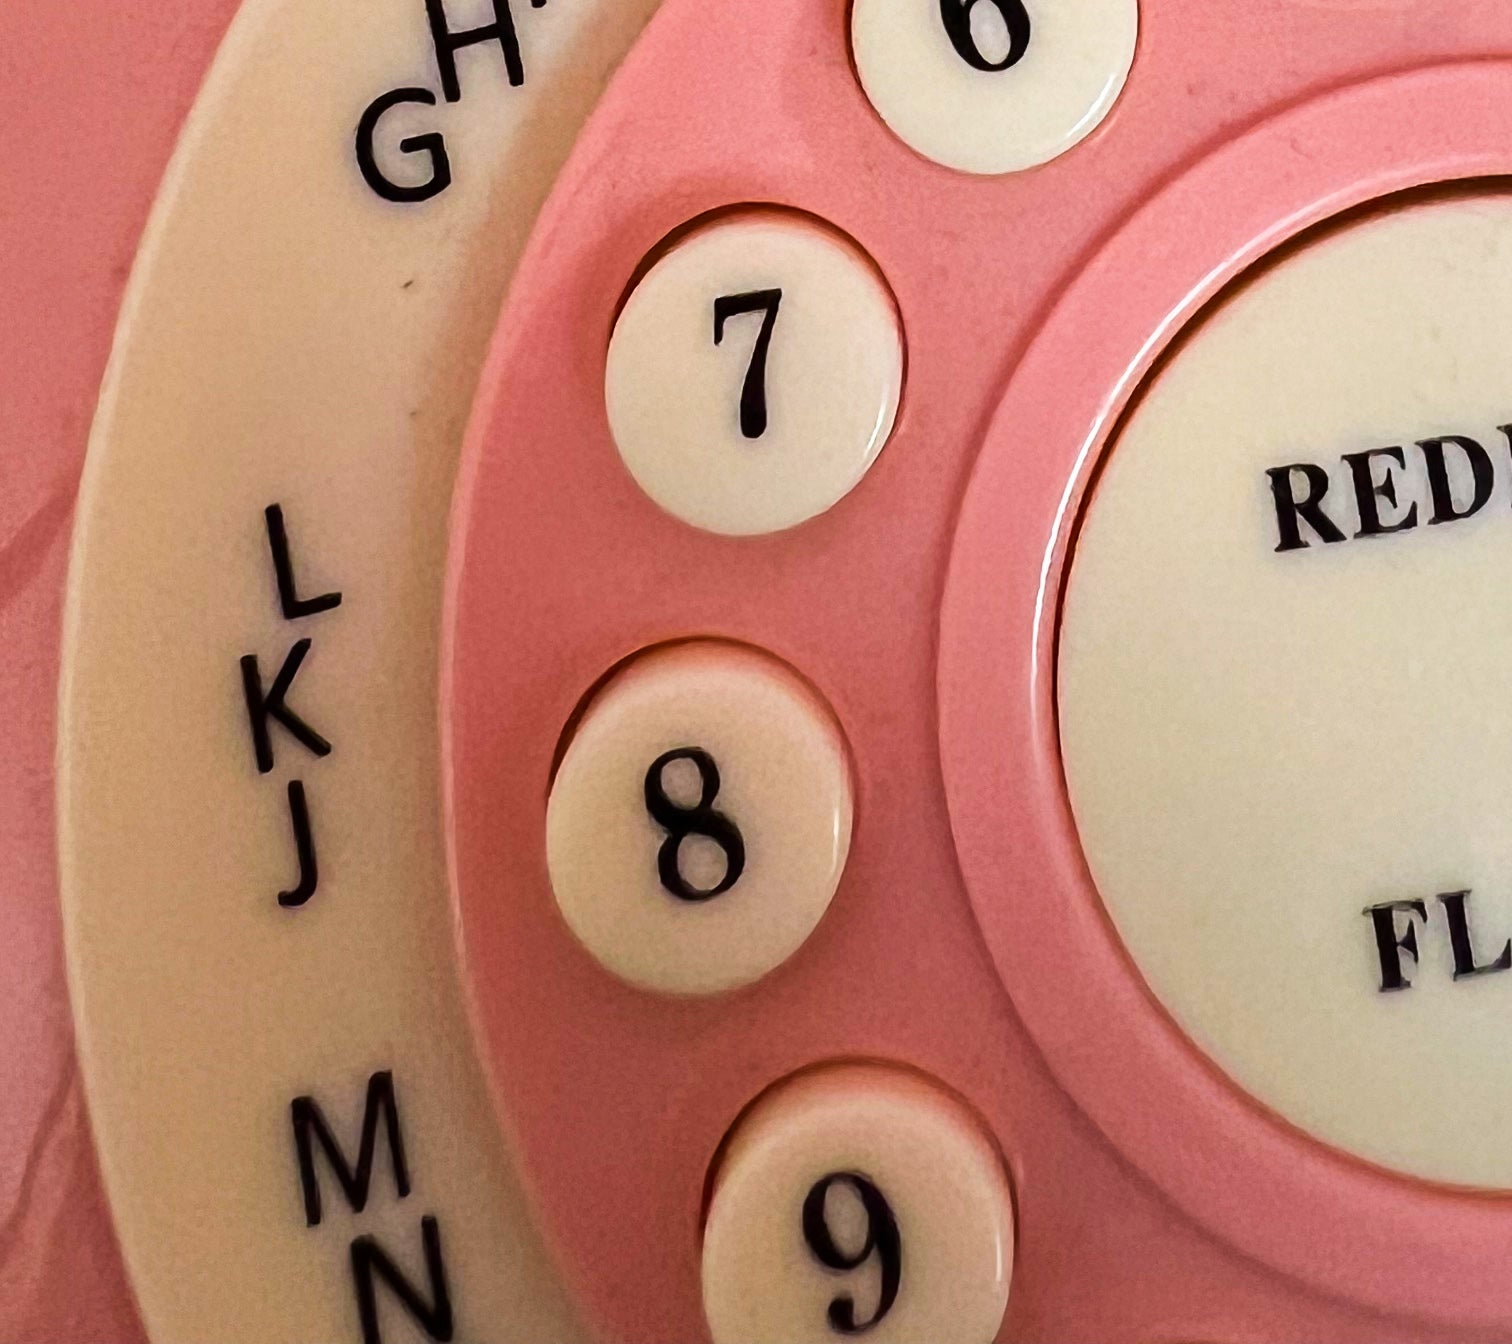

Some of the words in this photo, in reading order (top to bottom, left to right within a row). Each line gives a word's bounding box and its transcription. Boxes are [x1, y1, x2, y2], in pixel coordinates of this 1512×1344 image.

[713, 288, 783, 439] 7
[643, 744, 746, 903] 8
[801, 1168, 904, 1332] 9
